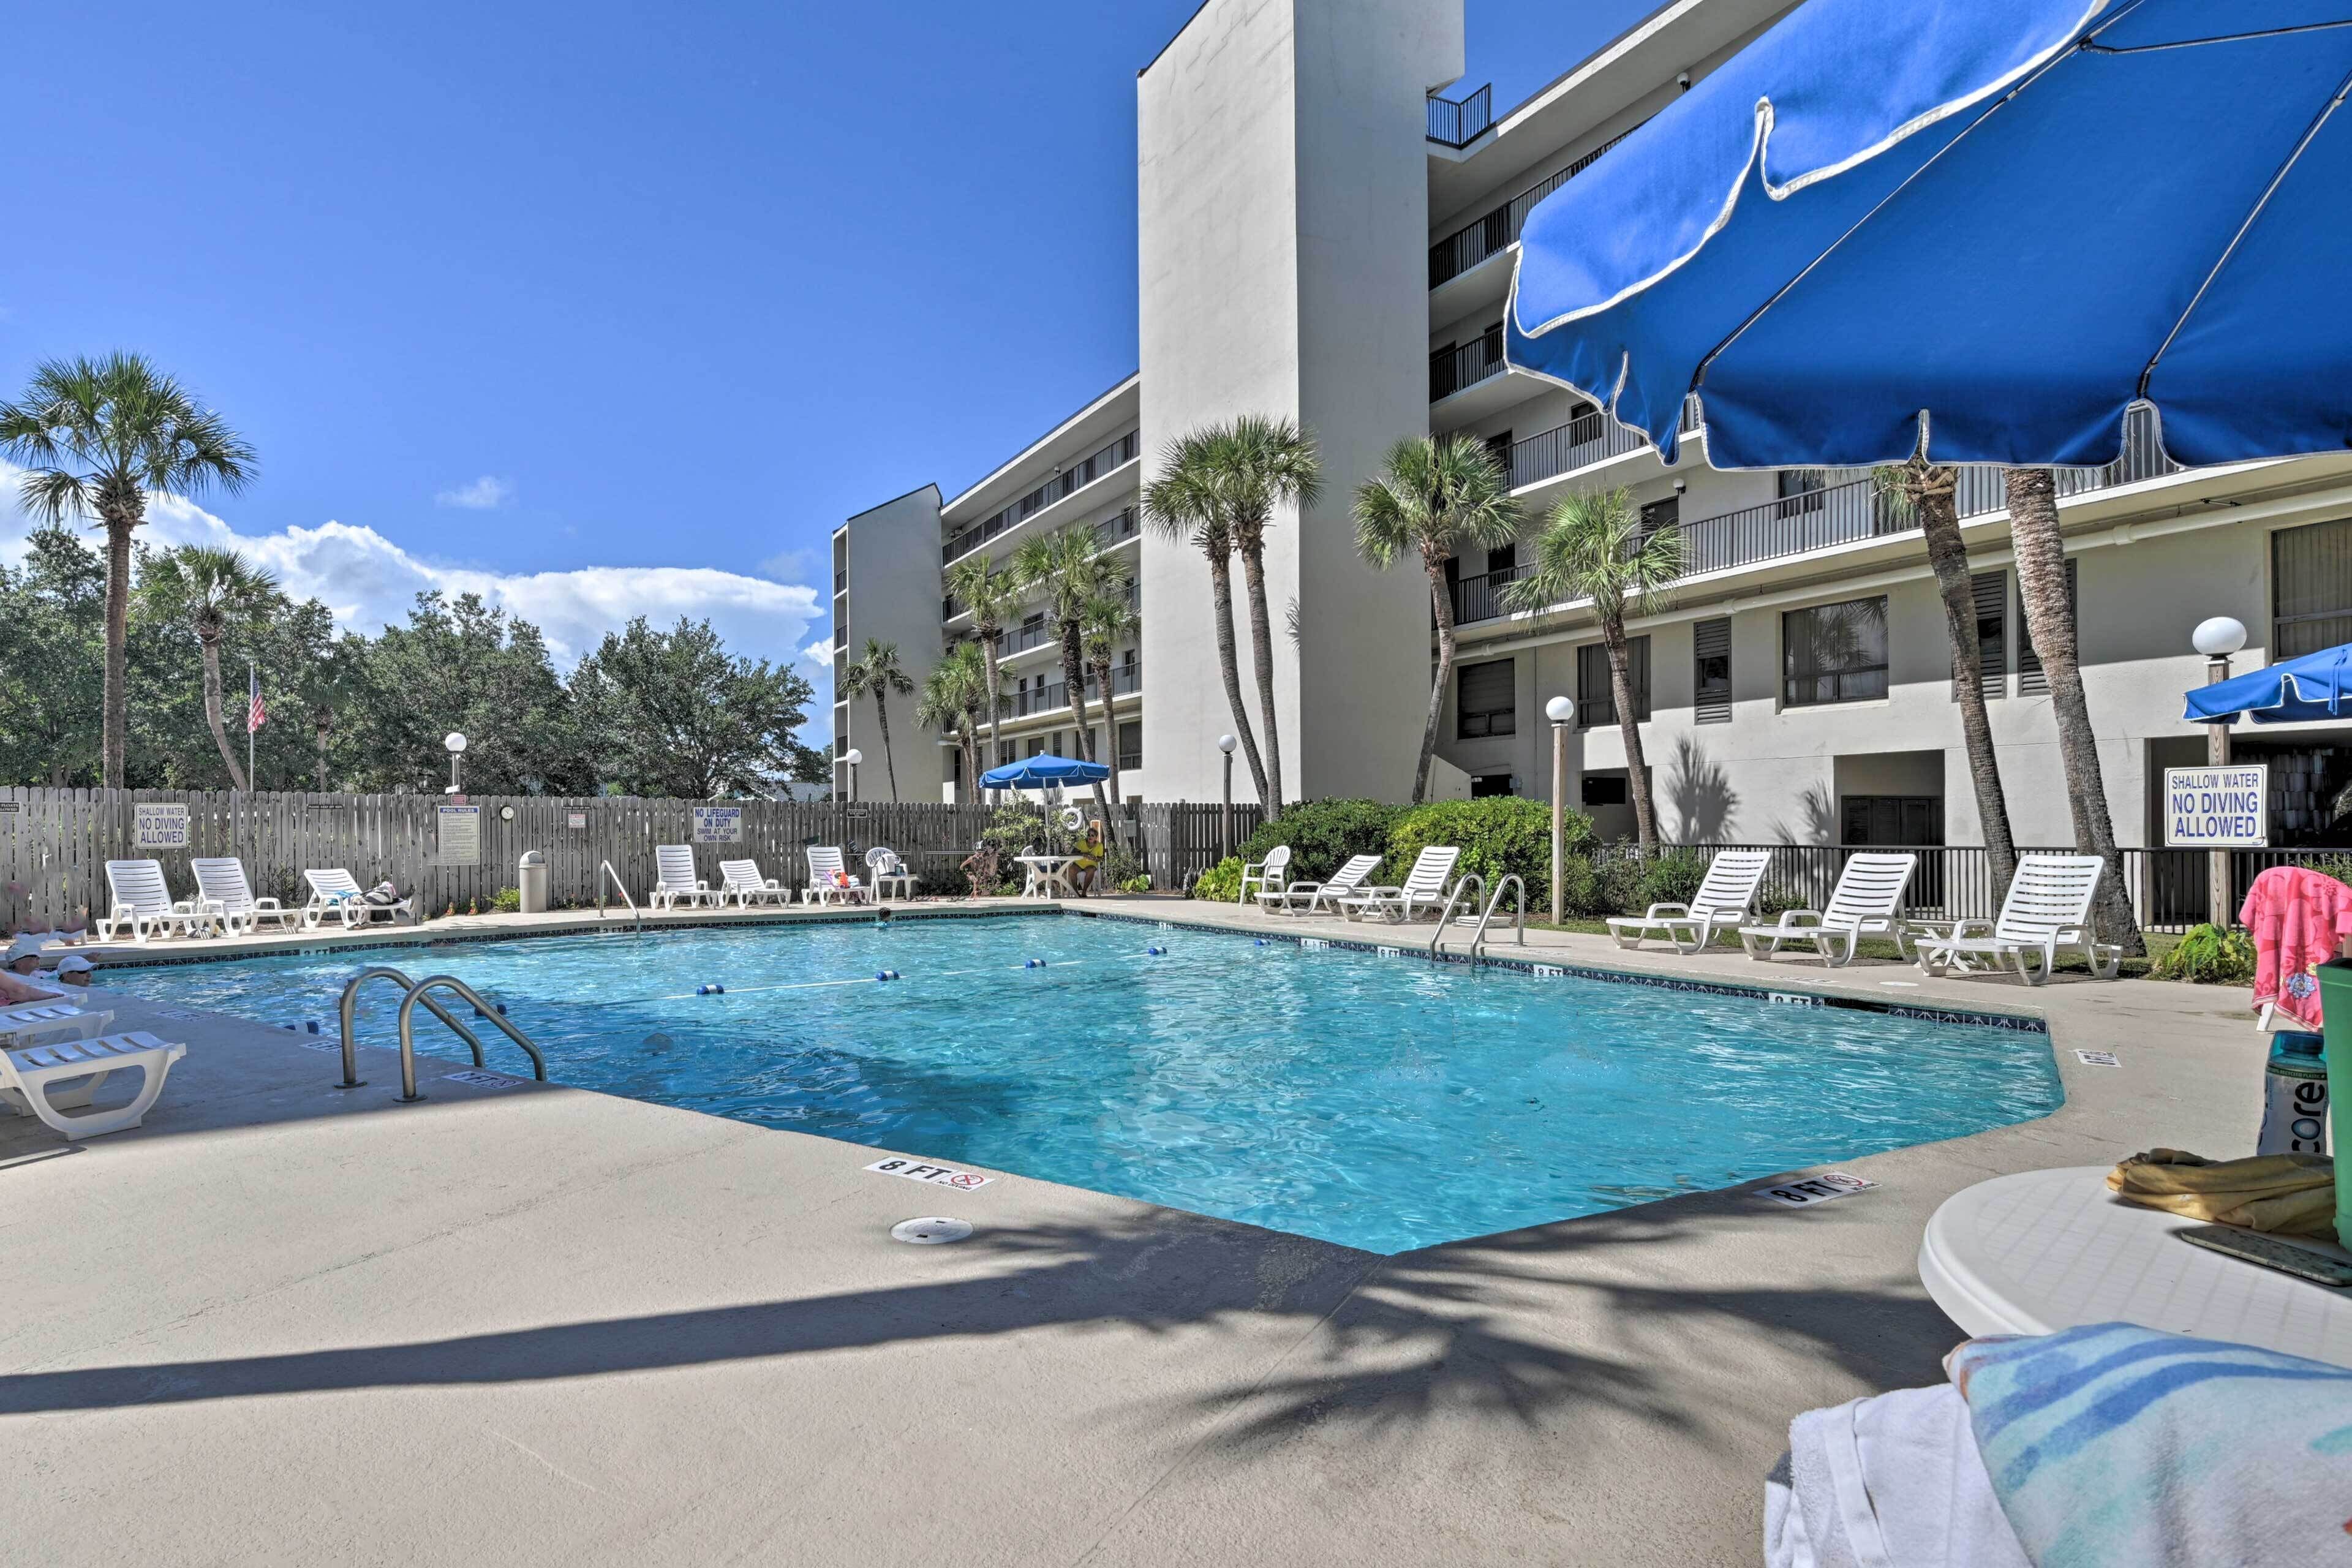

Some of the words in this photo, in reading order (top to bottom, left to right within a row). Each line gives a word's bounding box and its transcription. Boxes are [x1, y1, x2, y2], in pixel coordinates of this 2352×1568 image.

[2172, 774, 2219, 790] SHALLOW
[2223, 773, 2259, 788] WATER
[2173, 793, 2195, 814] NO
[2201, 791, 2258, 813] DIVING
[138, 807, 164, 816] SHALLOW
[166, 807, 184, 816] WATER
[695, 809, 704, 818] NO
[707, 809, 740, 818] LIFEGUARD
[139, 818, 151, 830] NO
[155, 818, 184, 830] DIVING
[704, 818, 713, 827] ON
[715, 818, 731, 827] DUTY
[2174, 816, 2256, 837] ALLOWED
[140, 831, 184, 843] ALLOWED
[1548, 968, 1562, 977] FT
[2291, 1082, 2325, 1153] core
[878, 1160, 907, 1170] 8
[903, 1165, 952, 1180] FT
[1770, 1189, 1809, 1202] 8
[1790, 1180, 1843, 1197] FT
